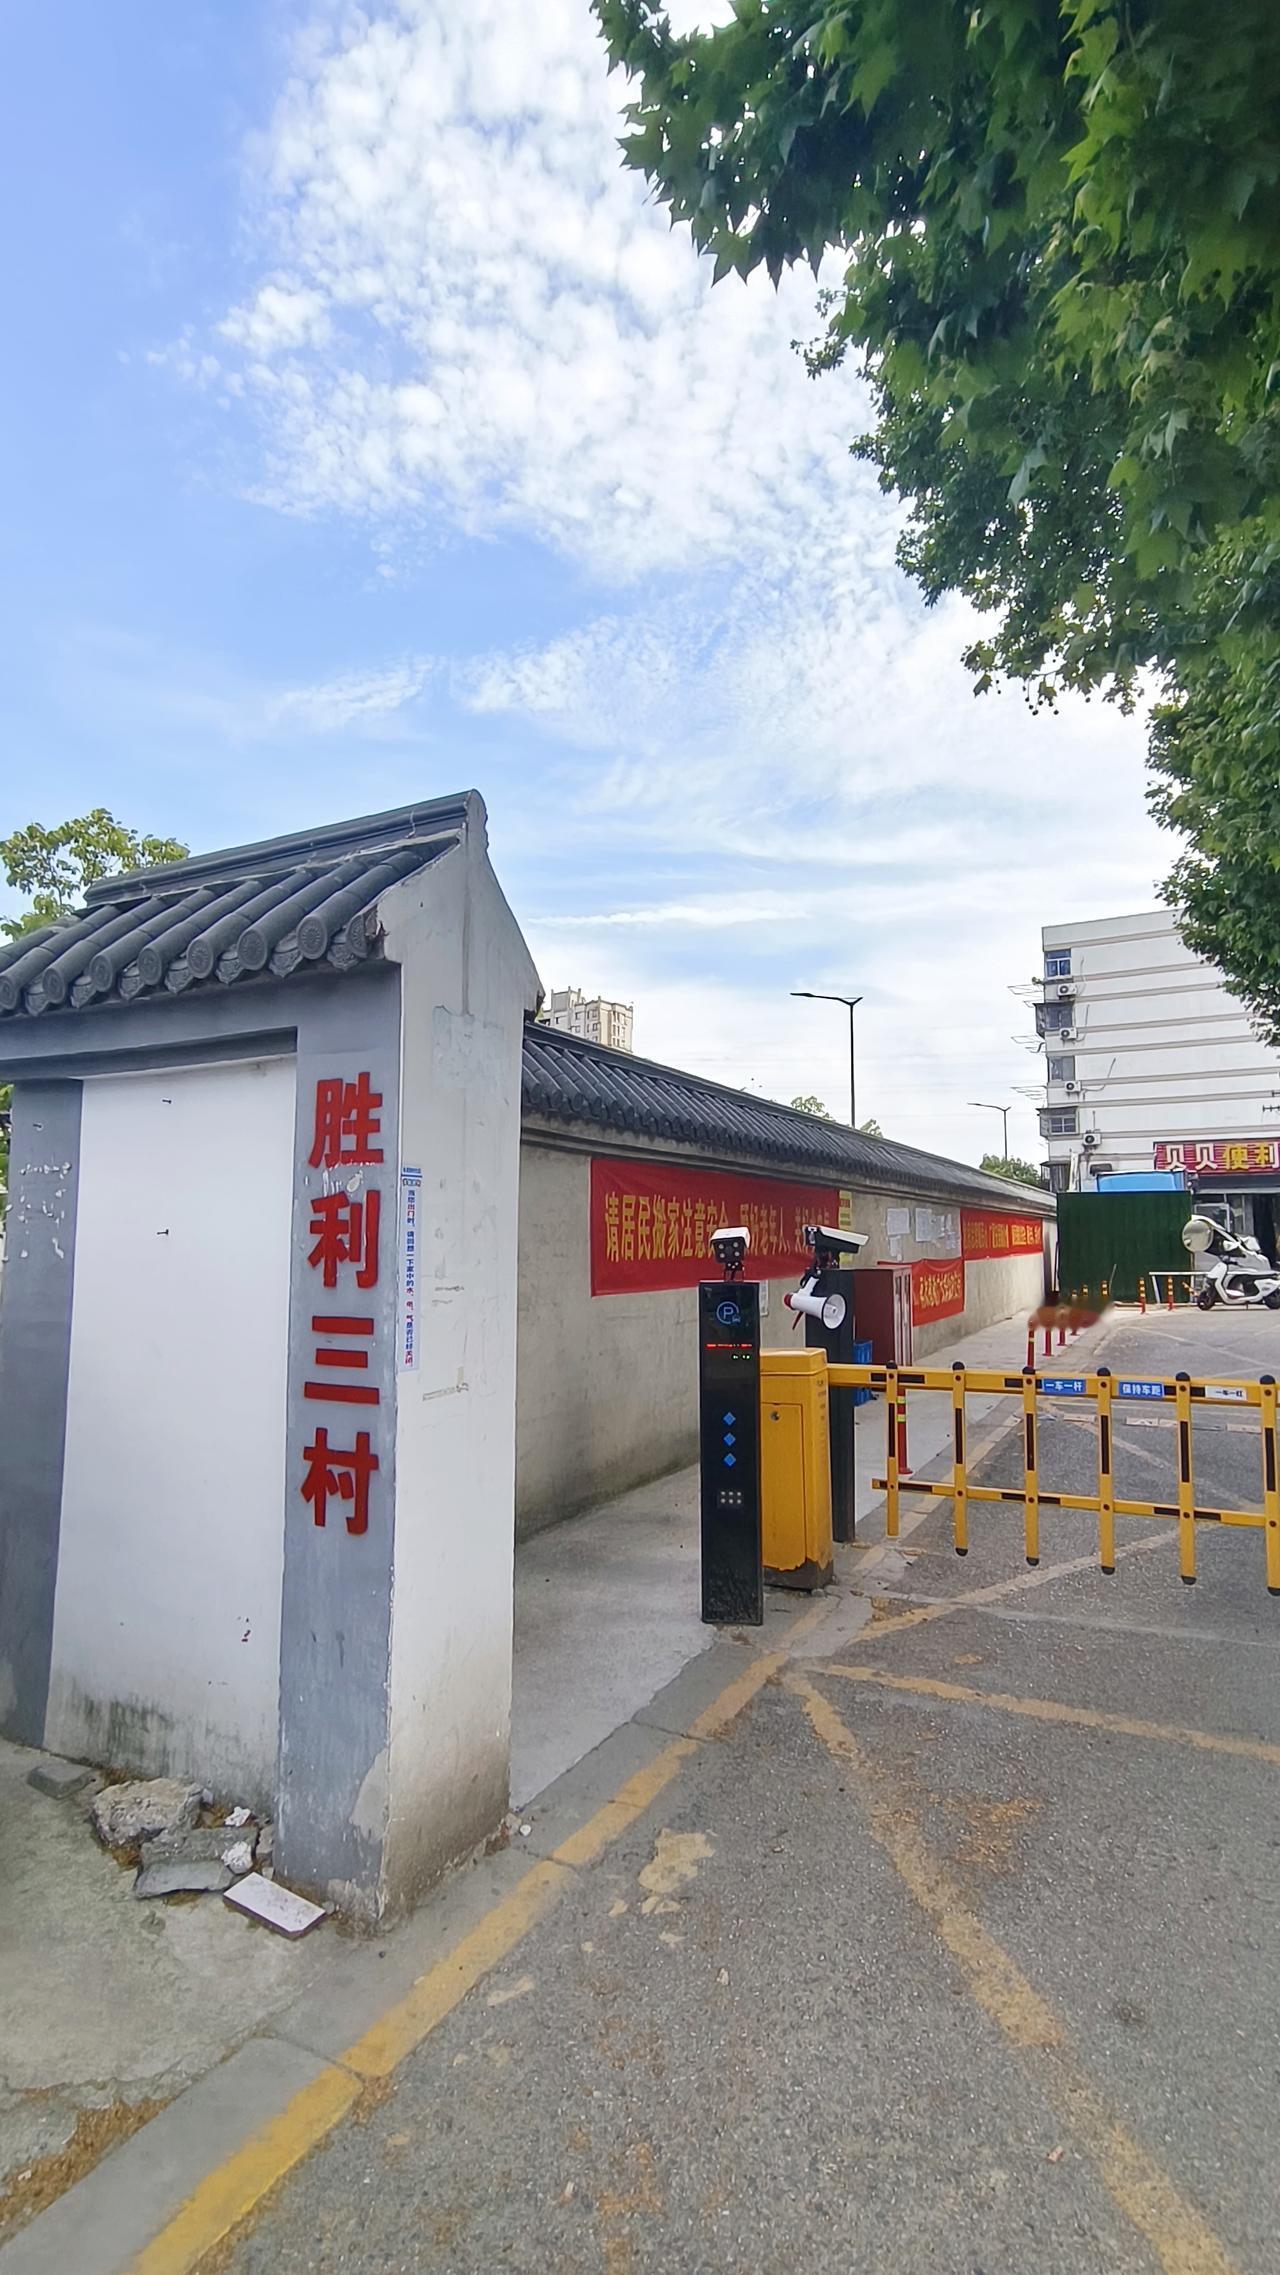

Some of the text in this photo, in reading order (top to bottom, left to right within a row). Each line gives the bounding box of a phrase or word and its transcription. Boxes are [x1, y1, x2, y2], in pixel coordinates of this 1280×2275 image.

[1165, 1142, 1280, 1170] 贝贝便利
[301, 1072, 384, 1535] 胜利三村
[1045, 1380, 1083, 1391] 一车一杆
[1122, 1382, 1161, 1397] 保持车距
